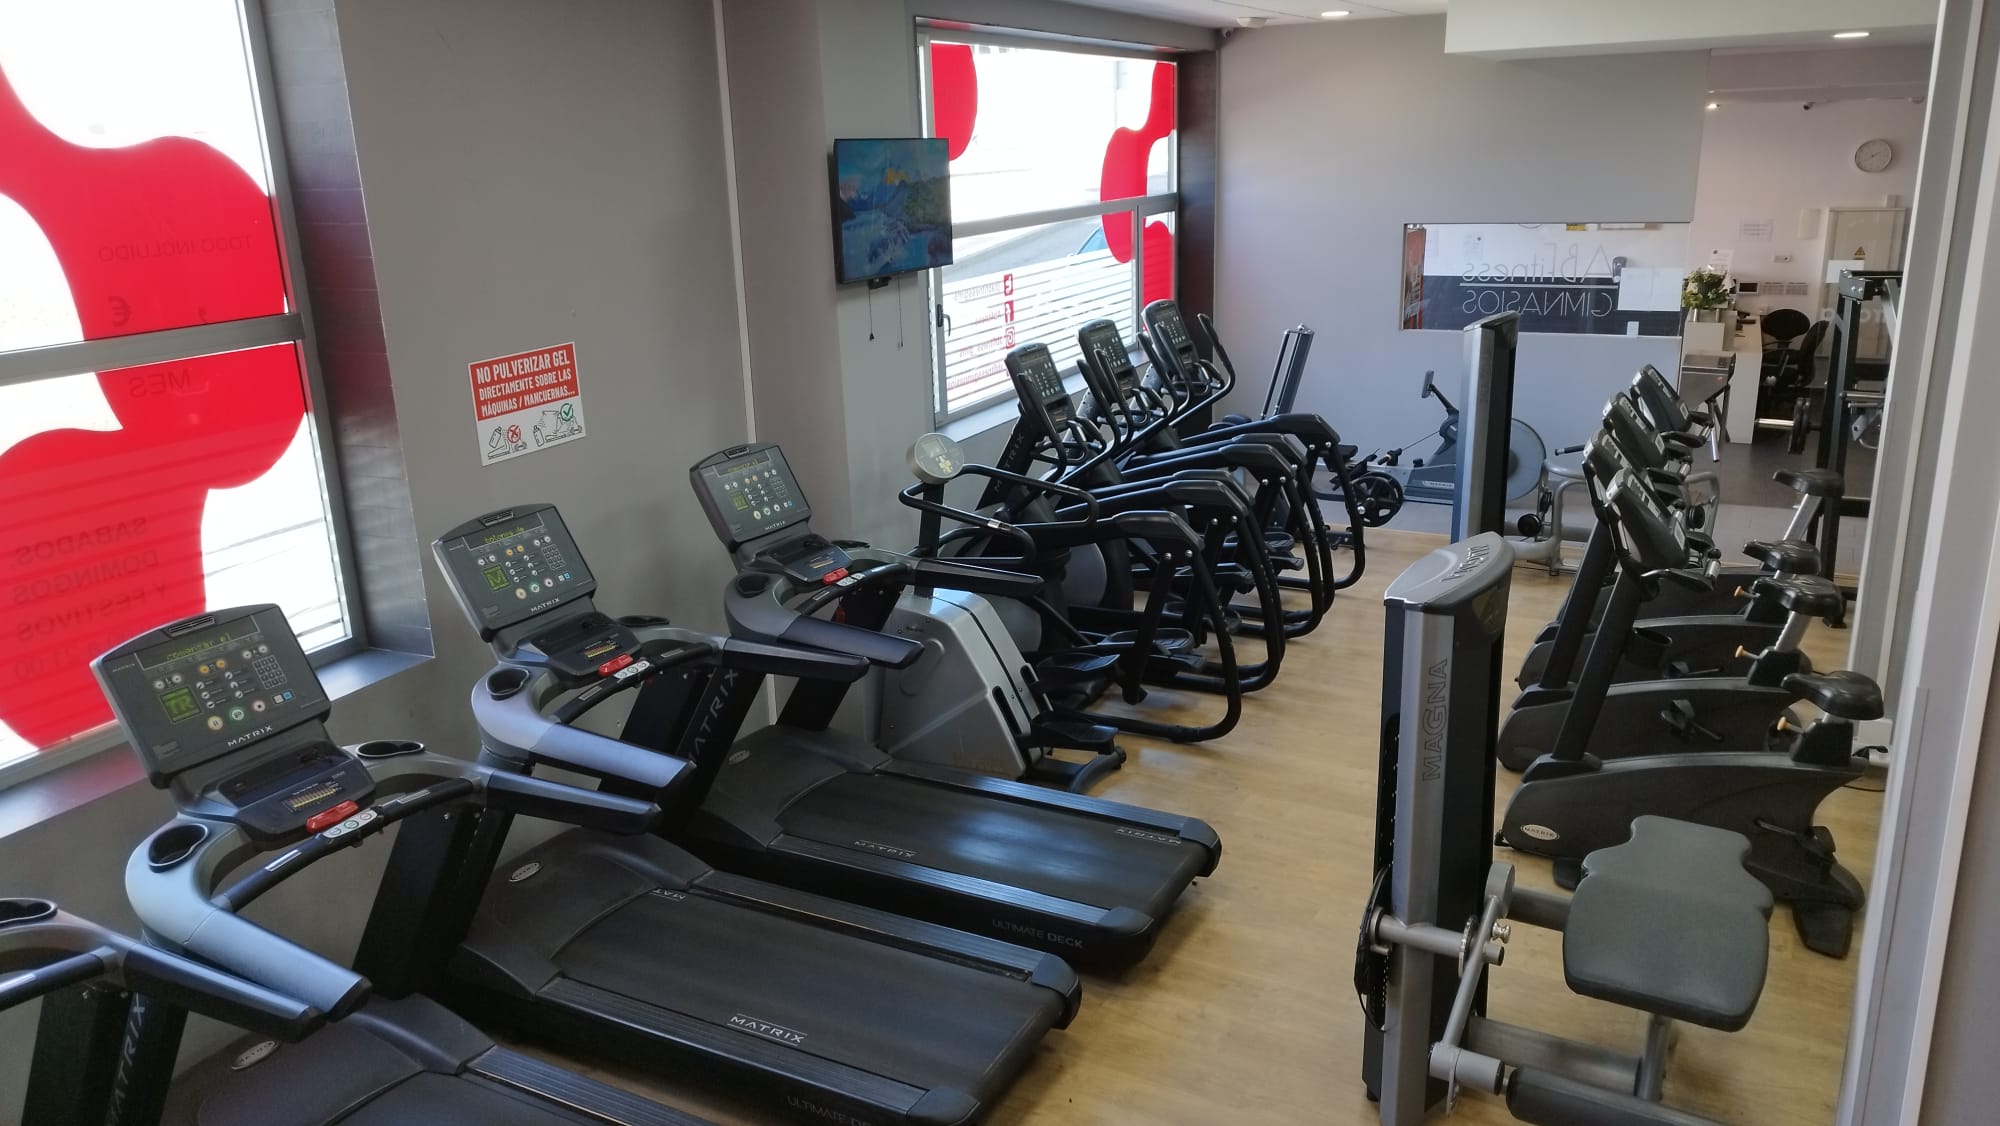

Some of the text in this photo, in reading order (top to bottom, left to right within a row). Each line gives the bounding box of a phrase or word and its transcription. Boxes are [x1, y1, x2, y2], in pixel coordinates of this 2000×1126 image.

[476, 349, 571, 385] NO PULVERIZAR GEL
[479, 368, 573, 401] DIRECTAMENTE SOBRE LAS
[530, 597, 560, 613] MATRIX
[1423, 658, 1448, 782] MAGNA
[227, 724, 273, 748] MATRIX
[992, 918, 1084, 949] ULTIMATE DECK
[730, 1015, 805, 1043] MATRIX
[787, 1095, 848, 1124] ULTIMATE
